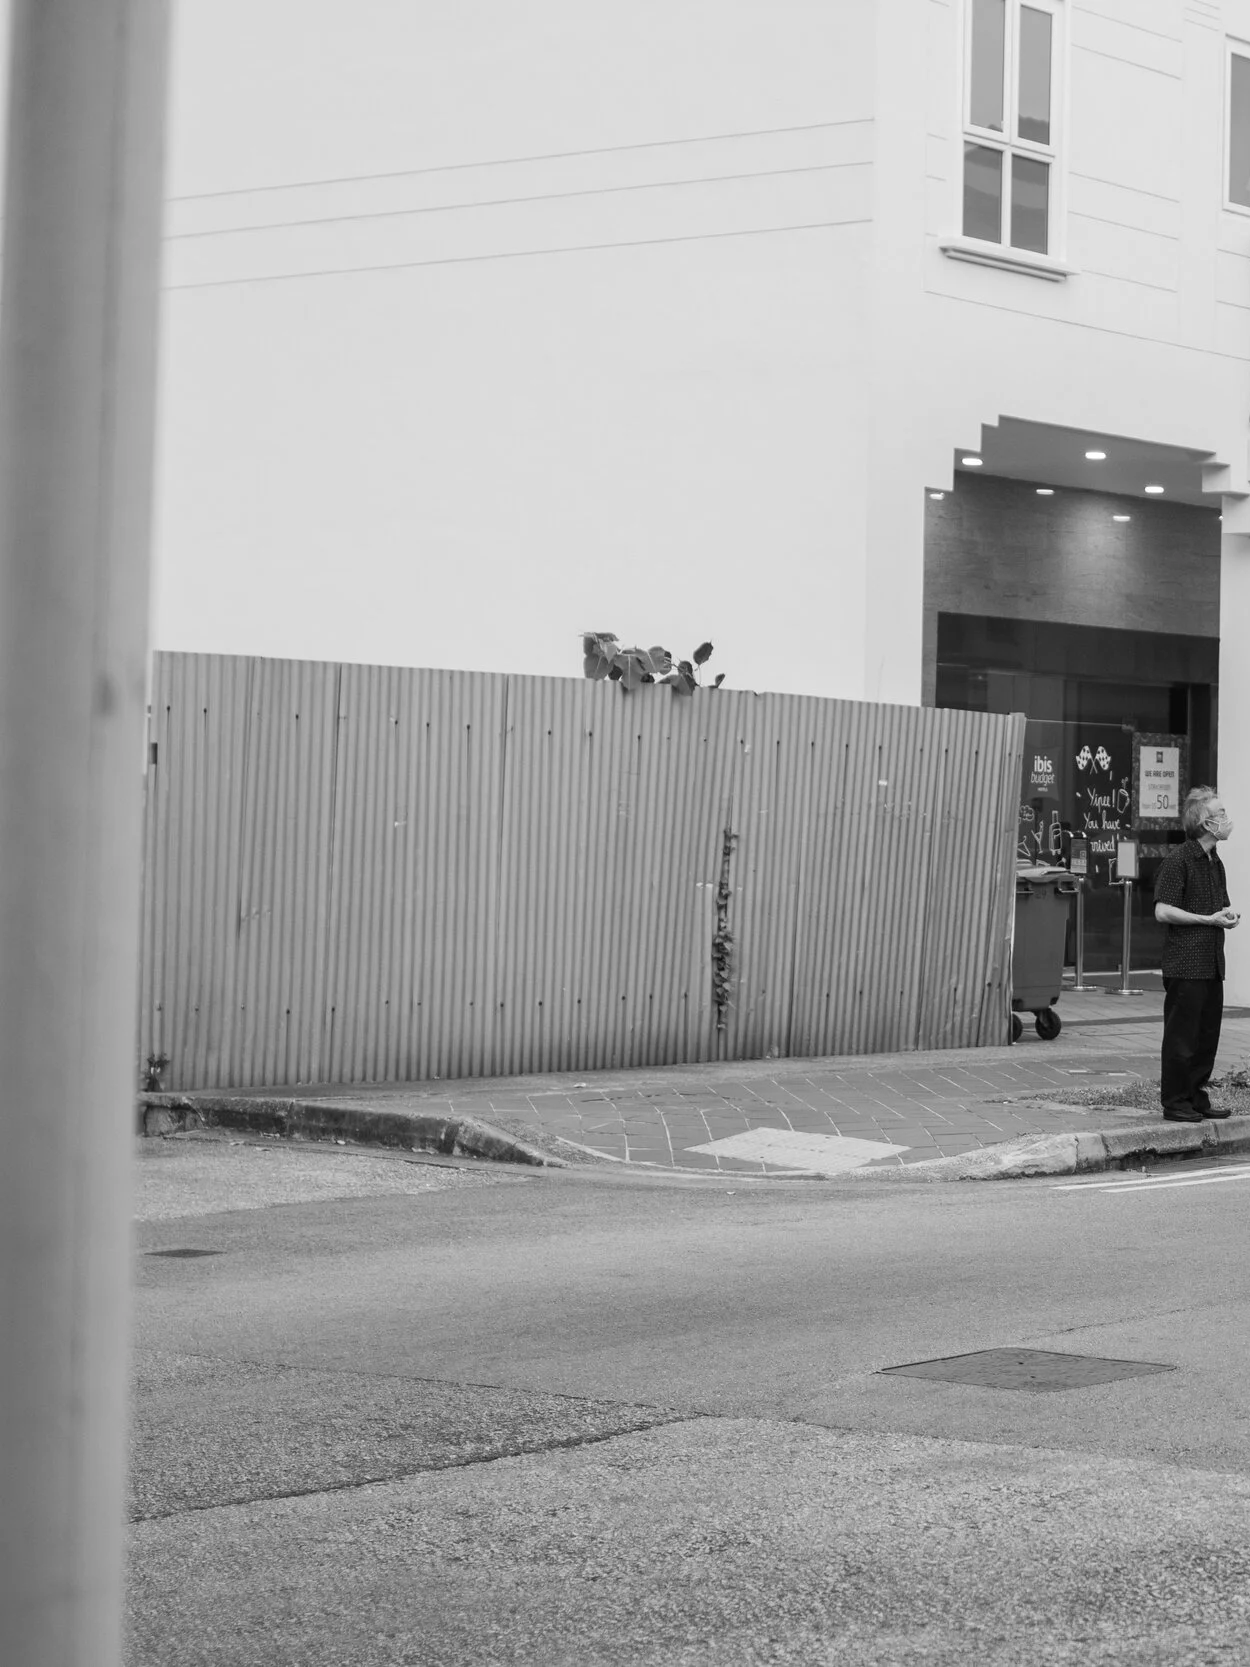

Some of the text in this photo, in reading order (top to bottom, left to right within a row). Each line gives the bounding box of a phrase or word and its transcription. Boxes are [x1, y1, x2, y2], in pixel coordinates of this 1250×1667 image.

[1034, 755, 1053, 772] ibis
[1030, 771, 1055, 786] budget
[1083, 811, 1099, 830] You
